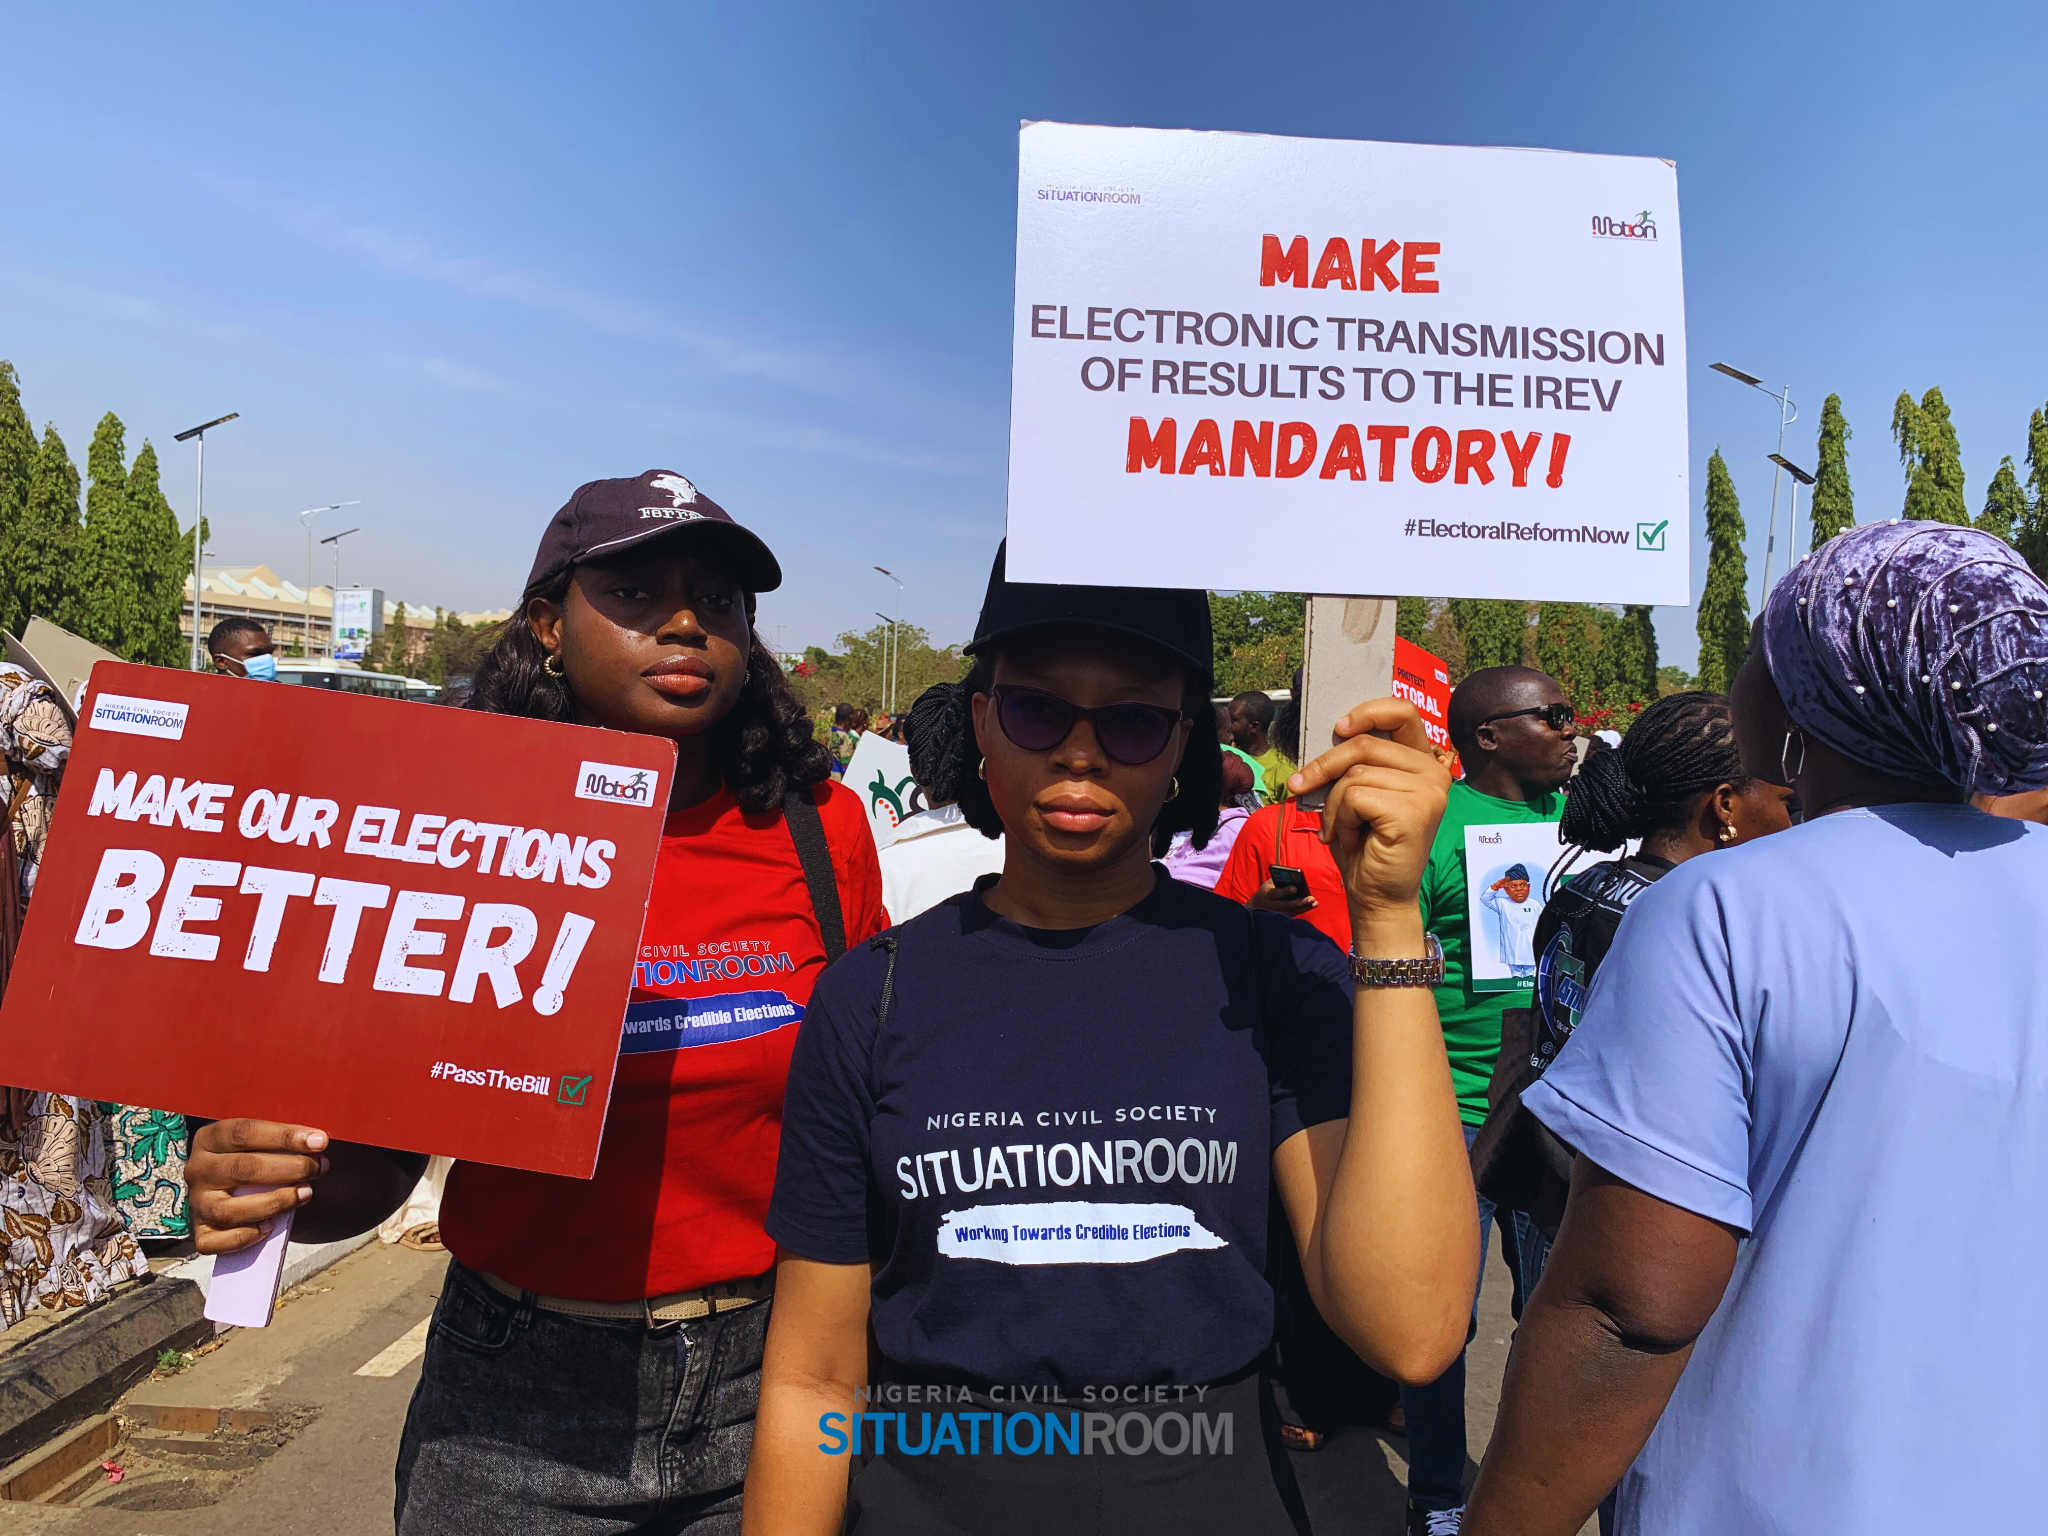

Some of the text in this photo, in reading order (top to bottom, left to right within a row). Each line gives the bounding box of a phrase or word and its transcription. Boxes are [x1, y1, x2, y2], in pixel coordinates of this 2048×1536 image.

[1037, 189, 1141, 204] SITUATIONROOM
[1259, 233, 1441, 294] MAKE
[1031, 304, 1665, 366] ELECTRONIC TRANSMISSION
[1080, 356, 1623, 412] OF RESULTS TO THE IREV
[1125, 416, 1572, 489] MANDATORY!
[1403, 518, 1630, 546] #ElectoralReformNow
[1397, 666, 1426, 690] PROTECT
[105, 703, 181, 717] NIGERIA CIVIL SOCIETY
[1391, 679, 1442, 718] CTORAL
[95, 707, 184, 729] SITUATIONROOM
[1422, 717, 1448, 747] RS?
[87, 767, 617, 889] MAKE OUR ELECTIONS
[74, 848, 596, 1016] BETTER!
[641, 940, 771, 958] CIVIL SOCIETY
[623, 1002, 796, 1035] wards Credible Elections
[430, 1061, 551, 1096] #PassTheBill
[926, 1105, 1217, 1131] NIGERIA CIVIL SOCIETY
[896, 1137, 1238, 1200] SITUATIONROOM
[955, 1223, 1191, 1244] Working Towards Credible Elections
